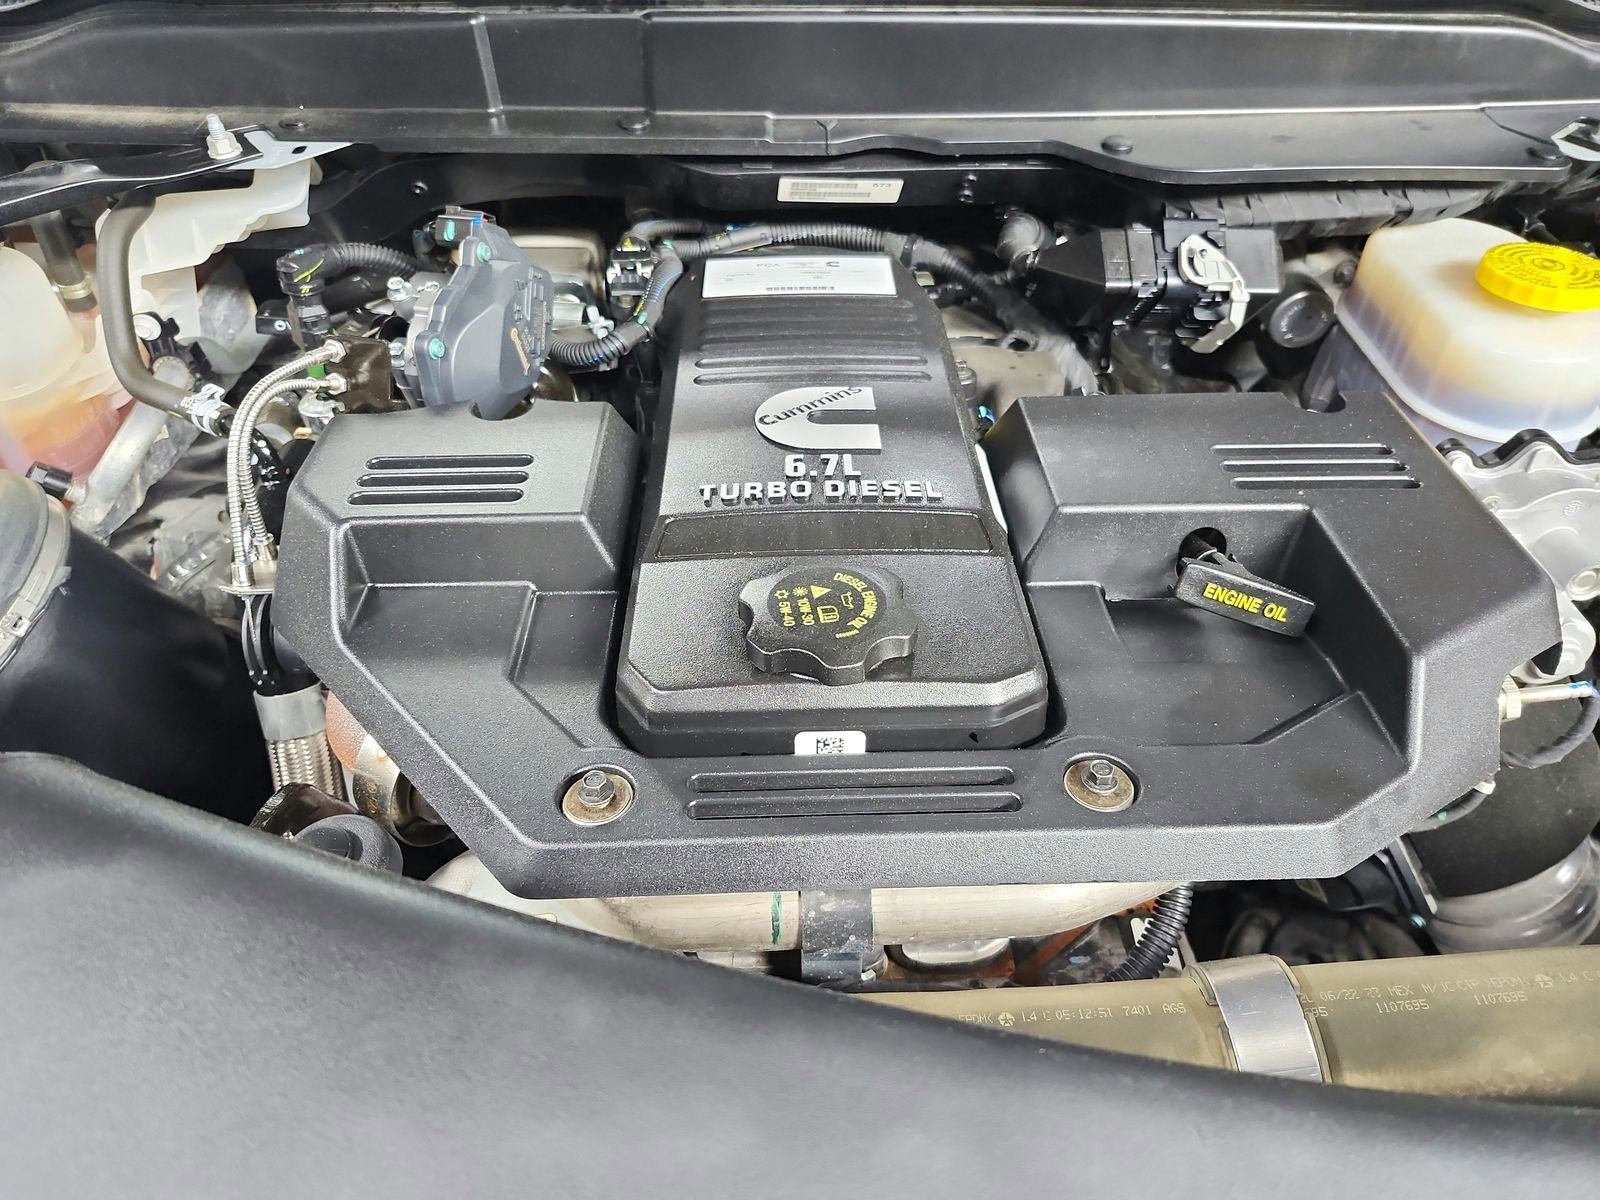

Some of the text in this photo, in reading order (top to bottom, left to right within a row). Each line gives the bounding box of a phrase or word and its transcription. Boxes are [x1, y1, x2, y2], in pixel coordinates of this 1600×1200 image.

[758, 387, 862, 426] Cummins
[784, 454, 862, 478] 6.7L
[699, 480, 944, 504] TURBO DIESEL
[797, 598, 815, 626] 10W-30
[834, 572, 878, 629] DIESEL ENGINE OIL
[1202, 582, 1288, 622] ENGINE OIL
[778, 601, 796, 627] 5W-40
[1121, 1004, 1153, 1017] 7401
[1375, 998, 1430, 1015] 1107695
[1474, 990, 1529, 1006] 1107695
